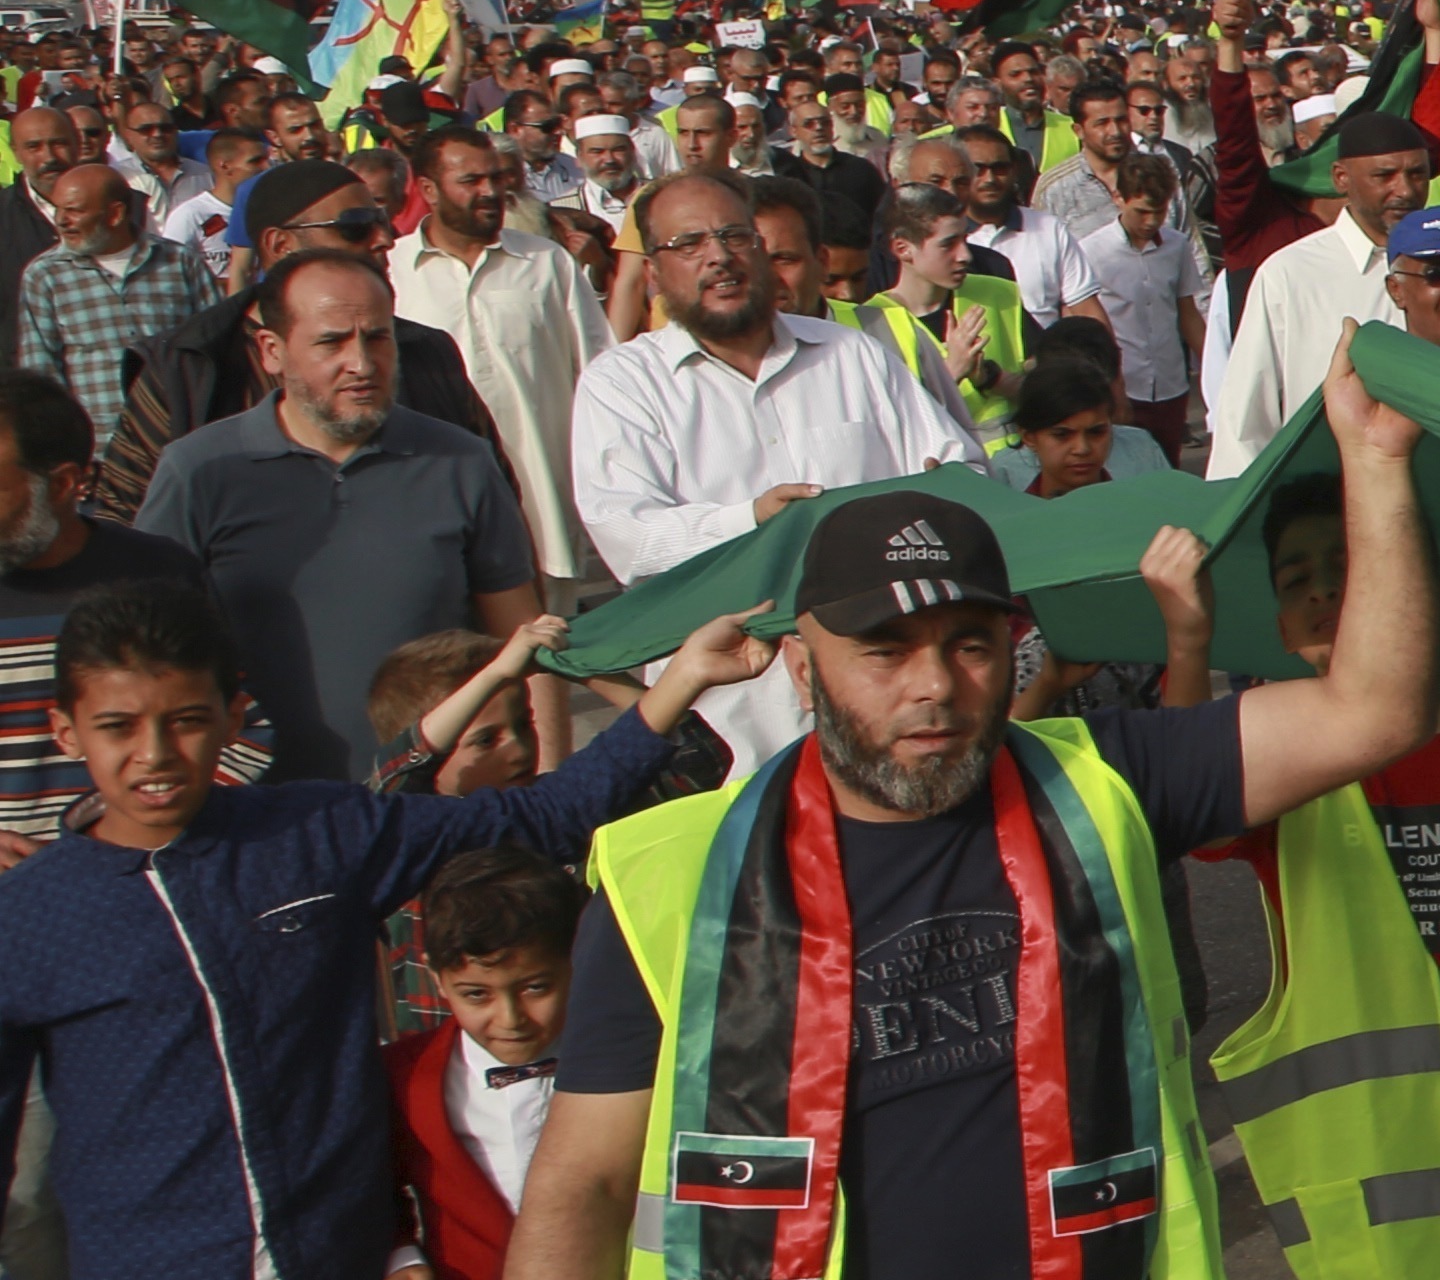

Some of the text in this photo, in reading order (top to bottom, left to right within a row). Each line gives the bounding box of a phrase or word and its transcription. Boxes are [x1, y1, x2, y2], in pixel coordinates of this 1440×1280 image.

[723, 23, 758, 40] ليبيا
[885, 546, 951, 561] adidas
[897, 922, 969, 952] CITY OF
[855, 930, 1018, 983] NEW YORK
[880, 964, 972, 997] VINTAGE
